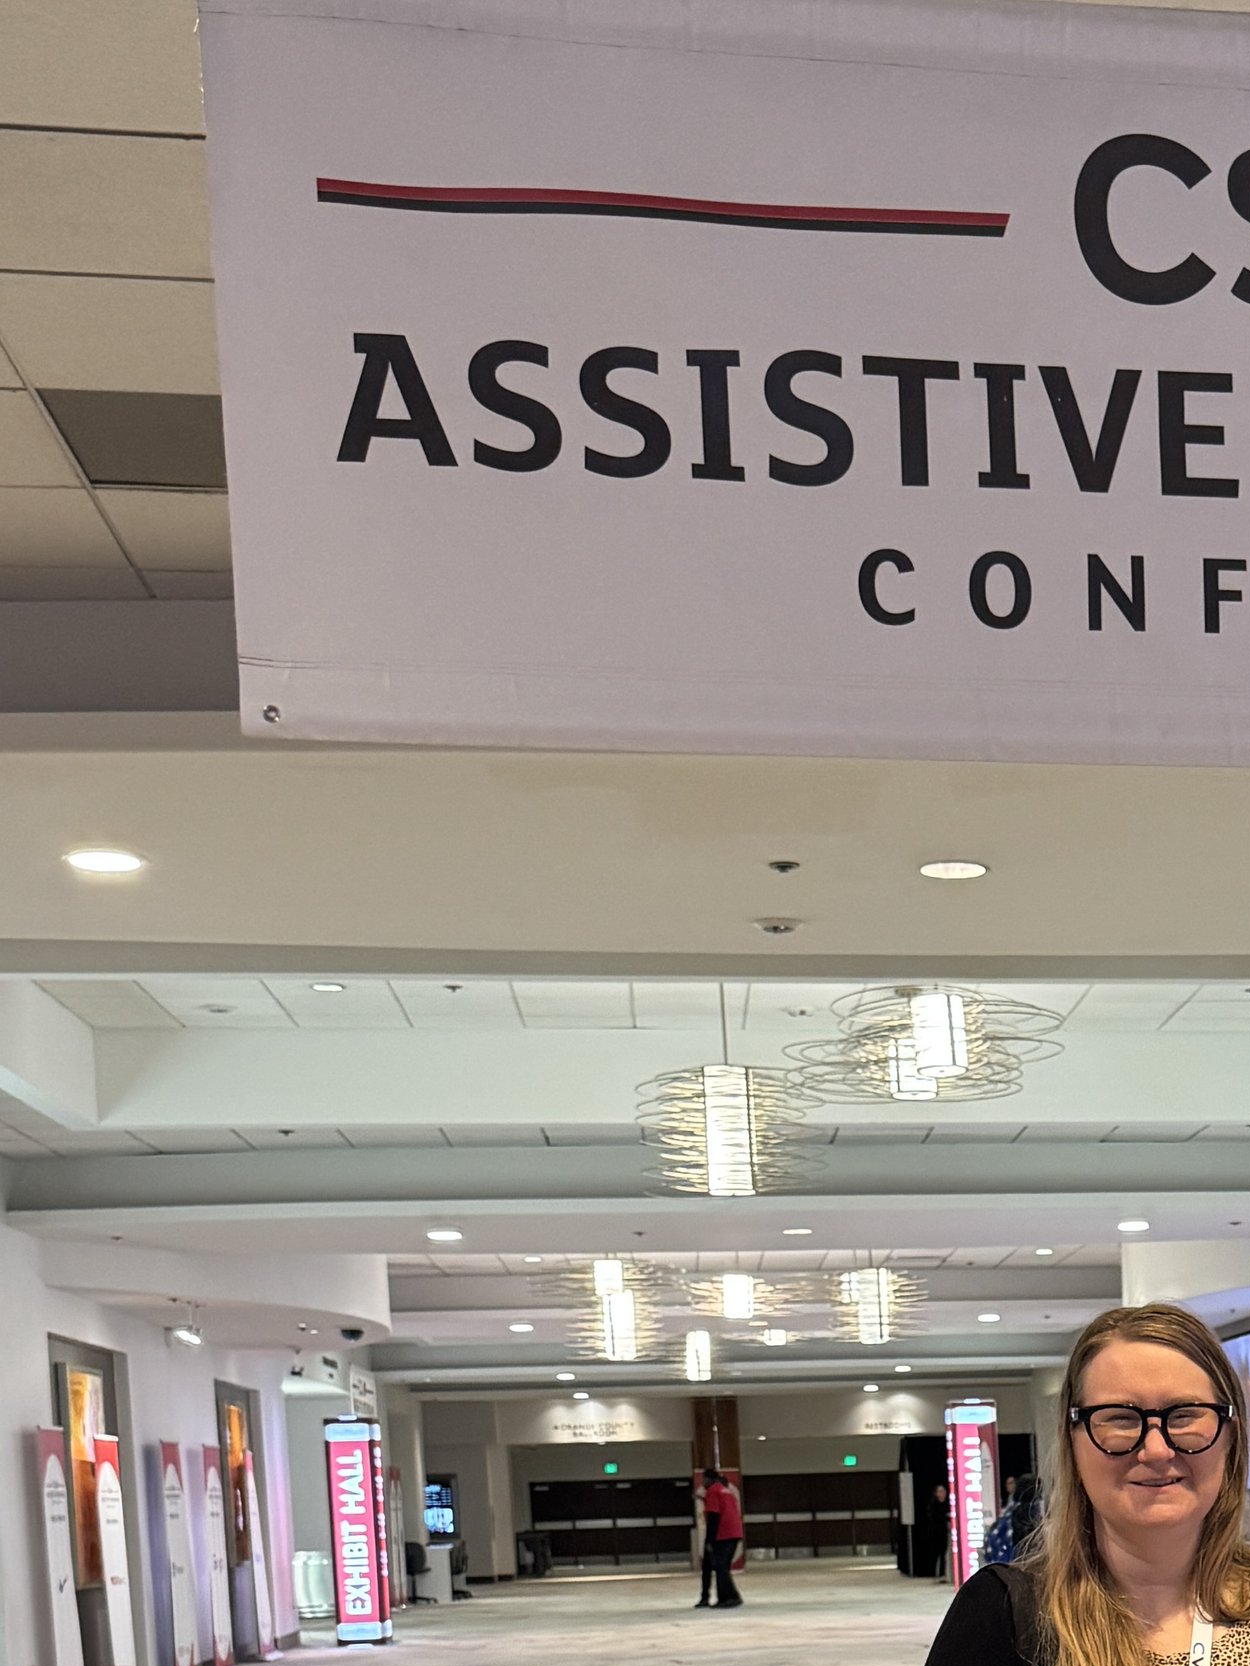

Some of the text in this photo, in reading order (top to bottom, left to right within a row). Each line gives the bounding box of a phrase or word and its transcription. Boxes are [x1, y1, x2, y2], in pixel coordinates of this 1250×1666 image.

[336, 332, 1241, 499] ASSISTIVE
[335, 1448, 367, 1515] HALL
[339, 1519, 372, 1616] EXHIBIT
[966, 1497, 985, 1576] HIBIT
